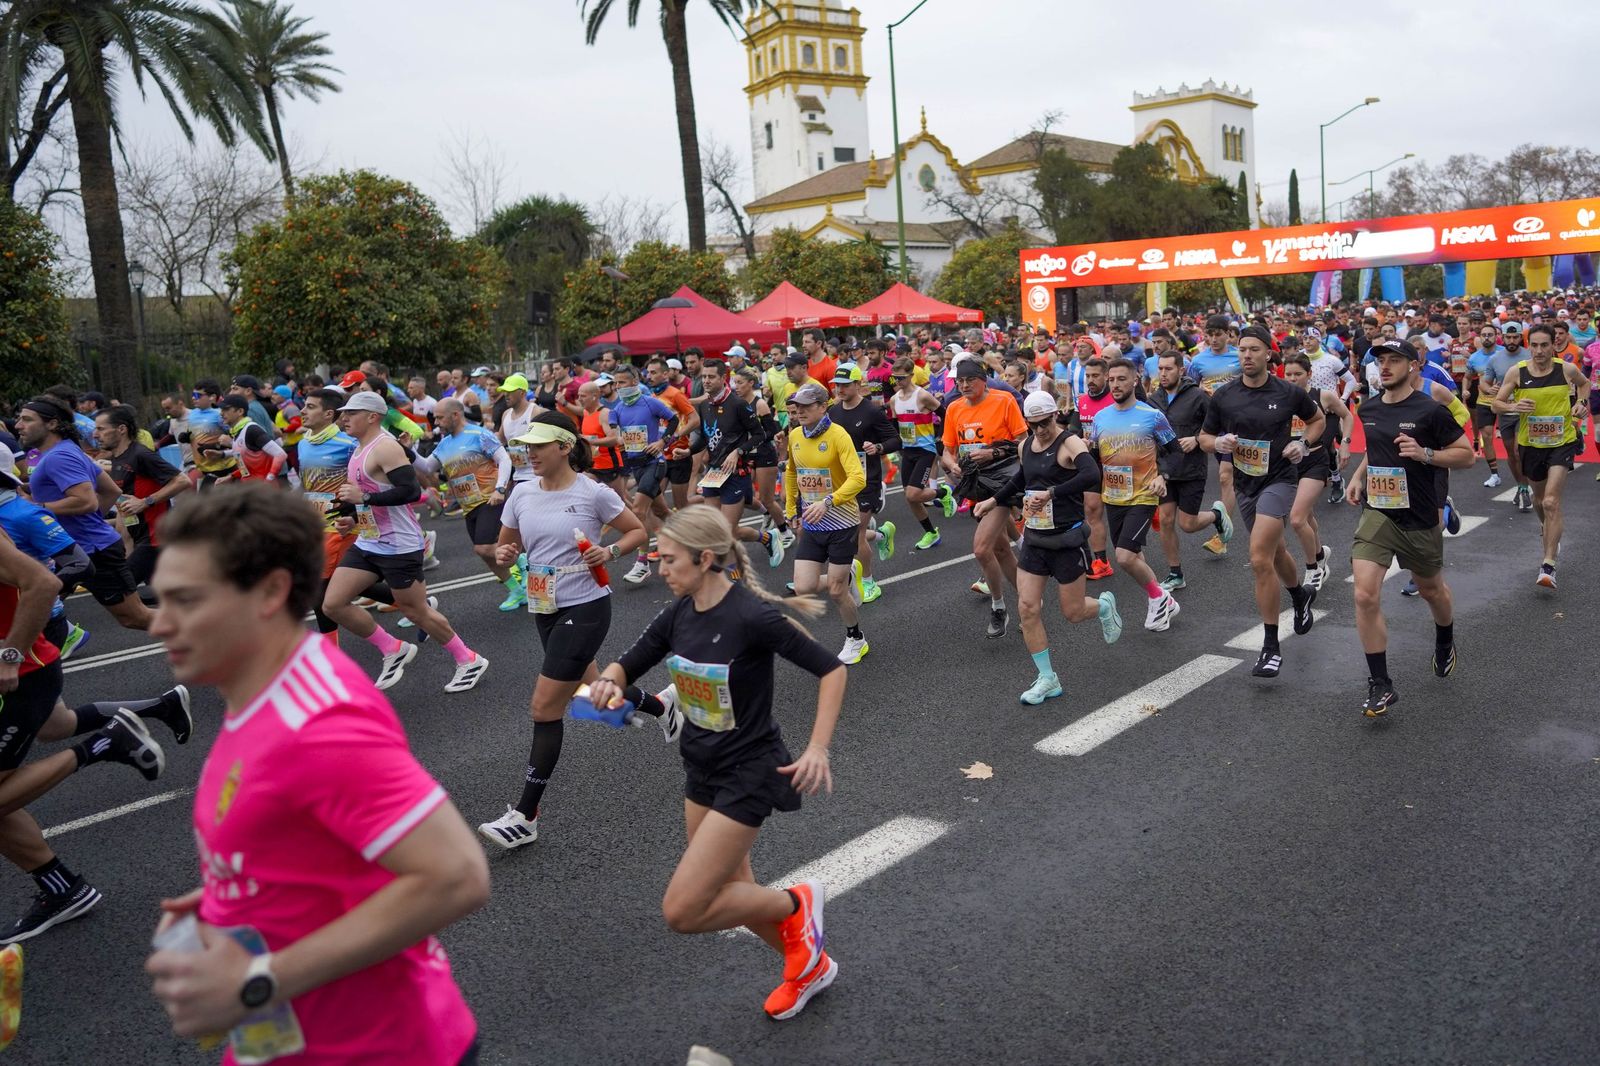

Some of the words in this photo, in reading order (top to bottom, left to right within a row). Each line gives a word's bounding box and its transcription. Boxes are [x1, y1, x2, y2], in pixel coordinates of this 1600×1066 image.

[1285, 231, 1353, 250] maratón
[1441, 224, 1498, 245] HOKA
[1507, 232, 1551, 243] HYUNDAI
[1174, 249, 1218, 266] HOKA
[1299, 244, 1356, 262] sevilla
[1533, 423, 1556, 433] 5298
[1236, 446, 1259, 460] 4499
[801, 476, 823, 488] 5234
[675, 672, 714, 702] 9355
